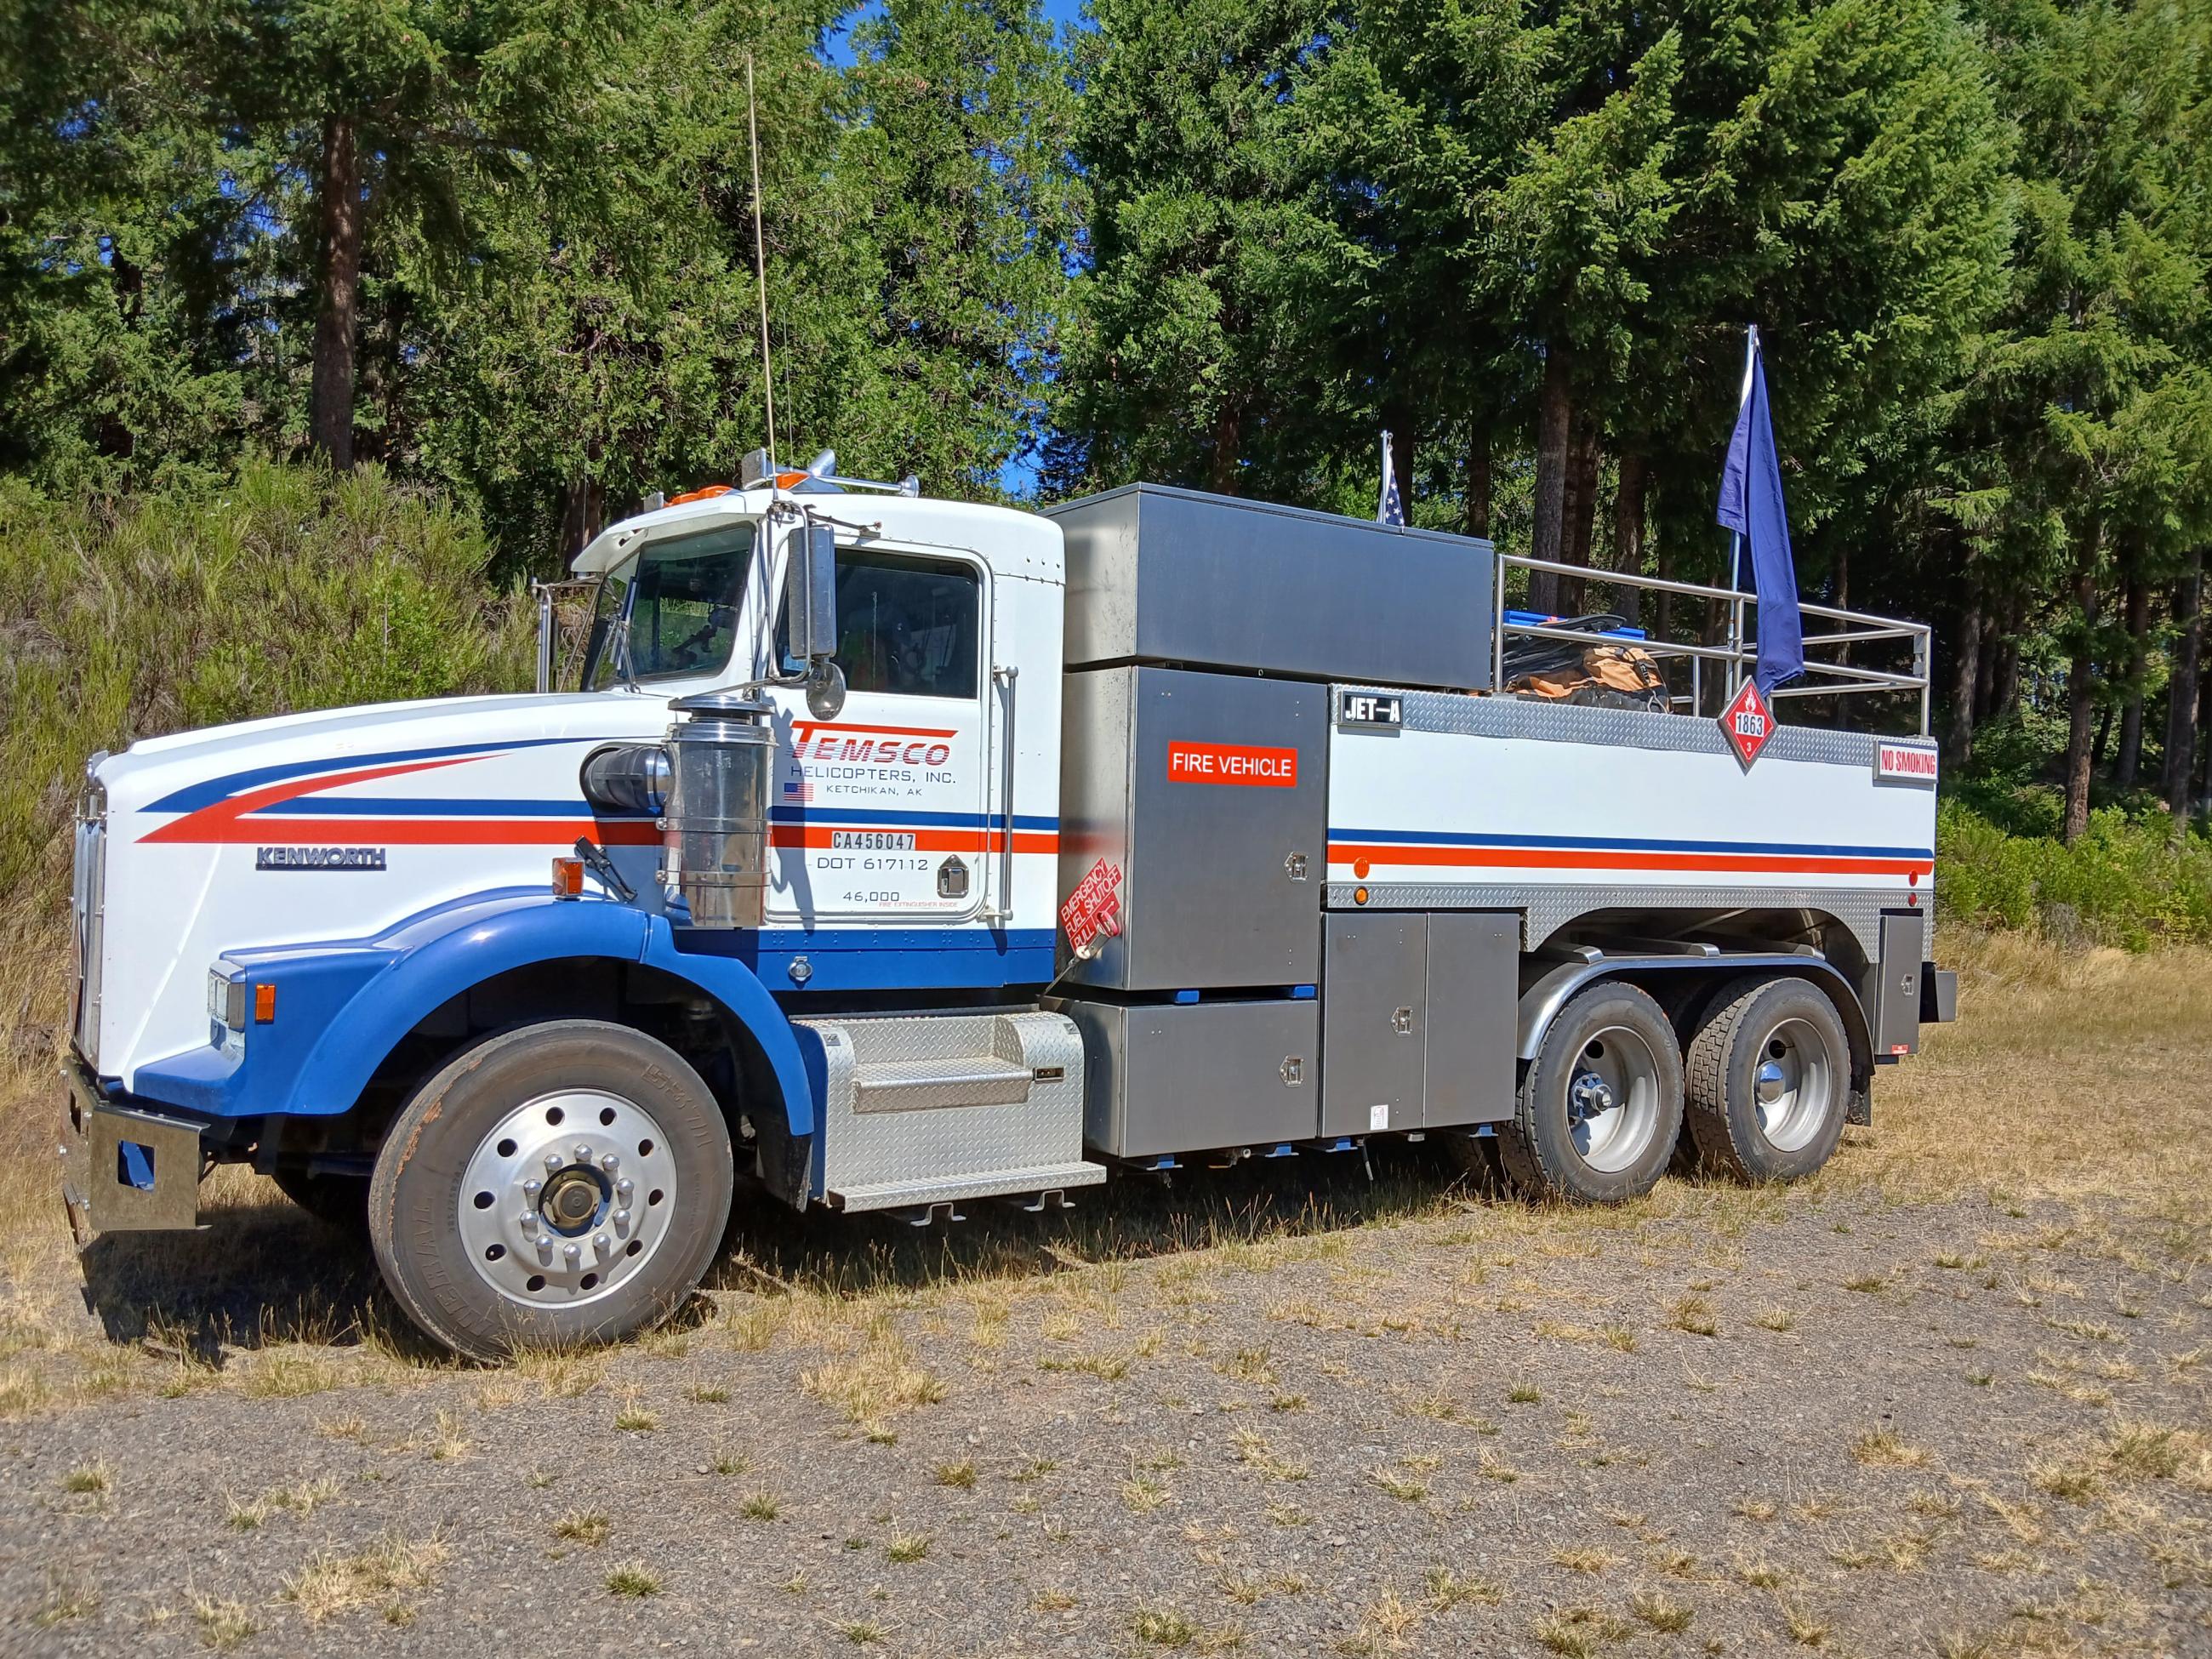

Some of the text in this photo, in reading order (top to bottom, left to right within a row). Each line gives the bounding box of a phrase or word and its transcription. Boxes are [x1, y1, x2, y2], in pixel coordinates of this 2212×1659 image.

[1345, 696, 1400, 723] JET-A
[1736, 713, 1763, 735] 1863
[790, 721, 959, 766] TEMSCO
[1746, 742, 1752, 752] 3
[1172, 752, 1291, 777] FIRE VEHICLE
[1881, 750, 1936, 774] NO SMOKING
[790, 766, 956, 784] HELICOPTERS, INC.
[825, 784, 923, 797] KETCHIKAN, AK
[833, 832, 915, 850] CA456047
[257, 847, 386, 865] KENWORTH
[817, 857, 929, 871] DOT 617112
[842, 891, 900, 904] 46,000
[1061, 860, 1106, 922] EMERGENCY
[1065, 866, 1119, 938] FUEL SHUTOFF
[1074, 924, 1095, 948] PULL
